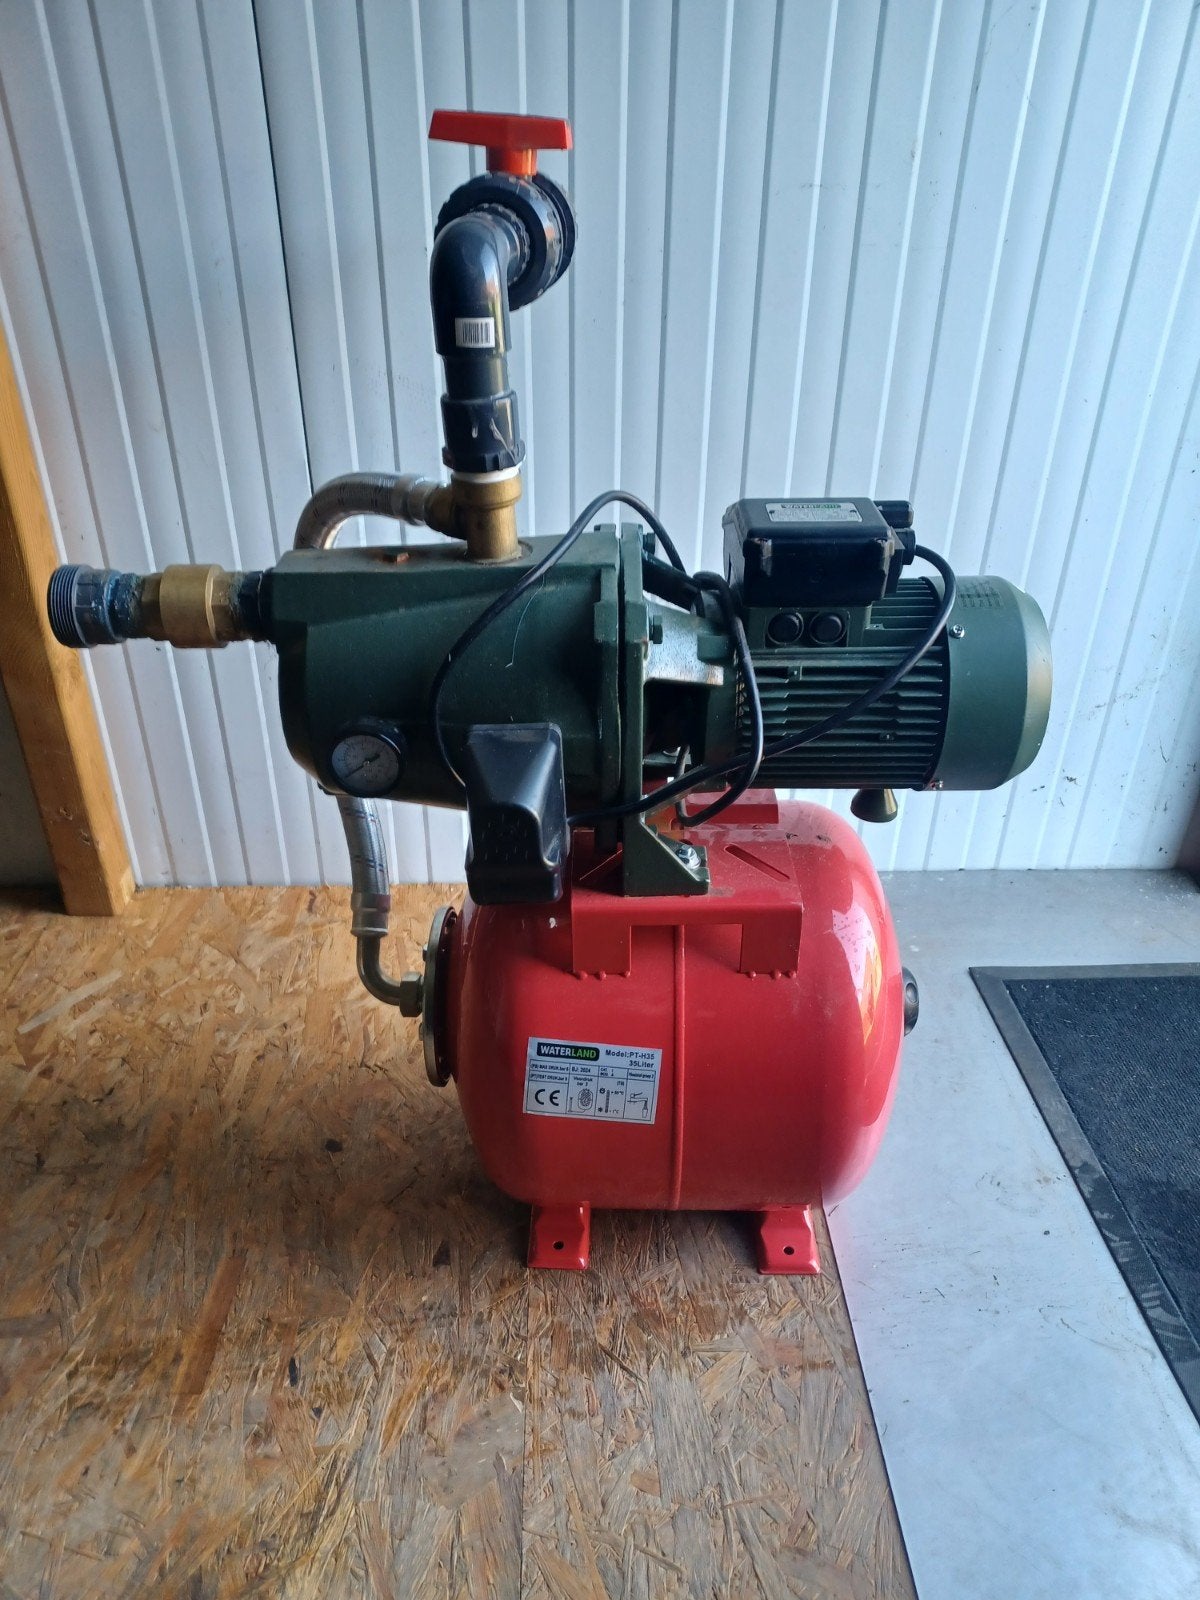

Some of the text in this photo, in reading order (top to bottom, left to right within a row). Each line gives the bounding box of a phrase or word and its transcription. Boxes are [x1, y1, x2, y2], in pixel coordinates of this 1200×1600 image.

[540, 1045, 597, 1059] WATERLAND
[605, 1049, 655, 1060] Model:PT-H35
[629, 1060, 654, 1068] 35Liter
